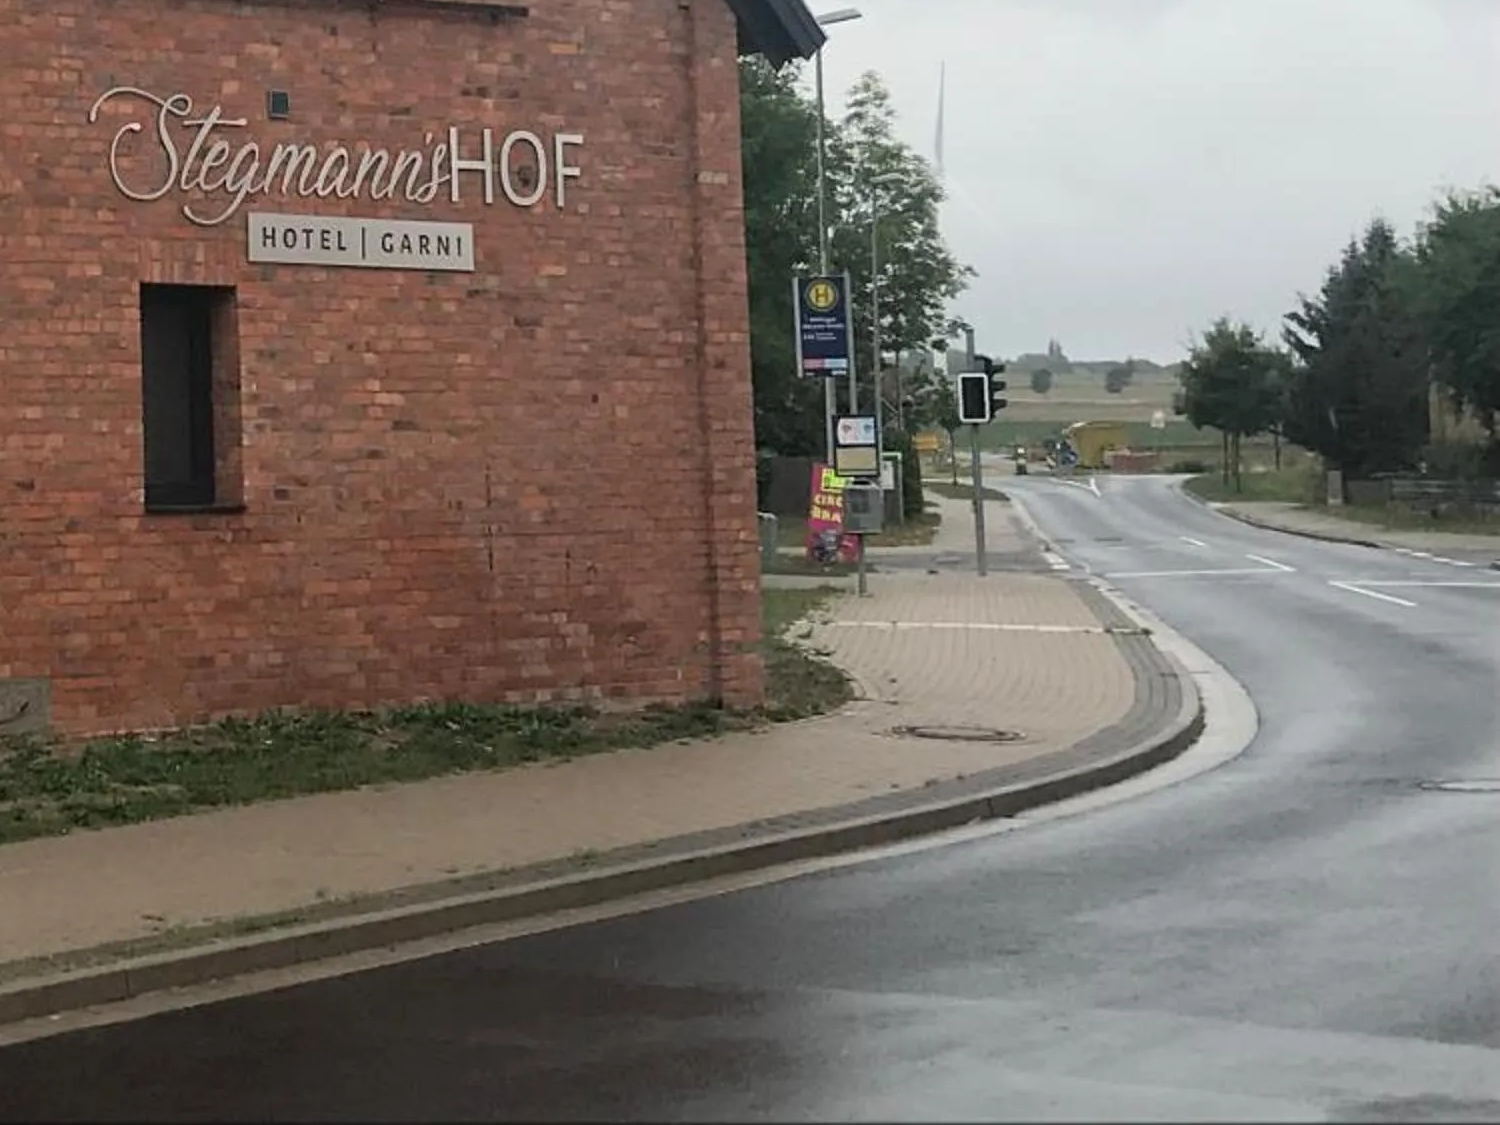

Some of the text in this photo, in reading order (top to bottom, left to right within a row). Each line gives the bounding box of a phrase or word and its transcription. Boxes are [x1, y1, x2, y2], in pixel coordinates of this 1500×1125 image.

[261, 225, 463, 258] HOTEL GARNI
[814, 286, 830, 305] H
